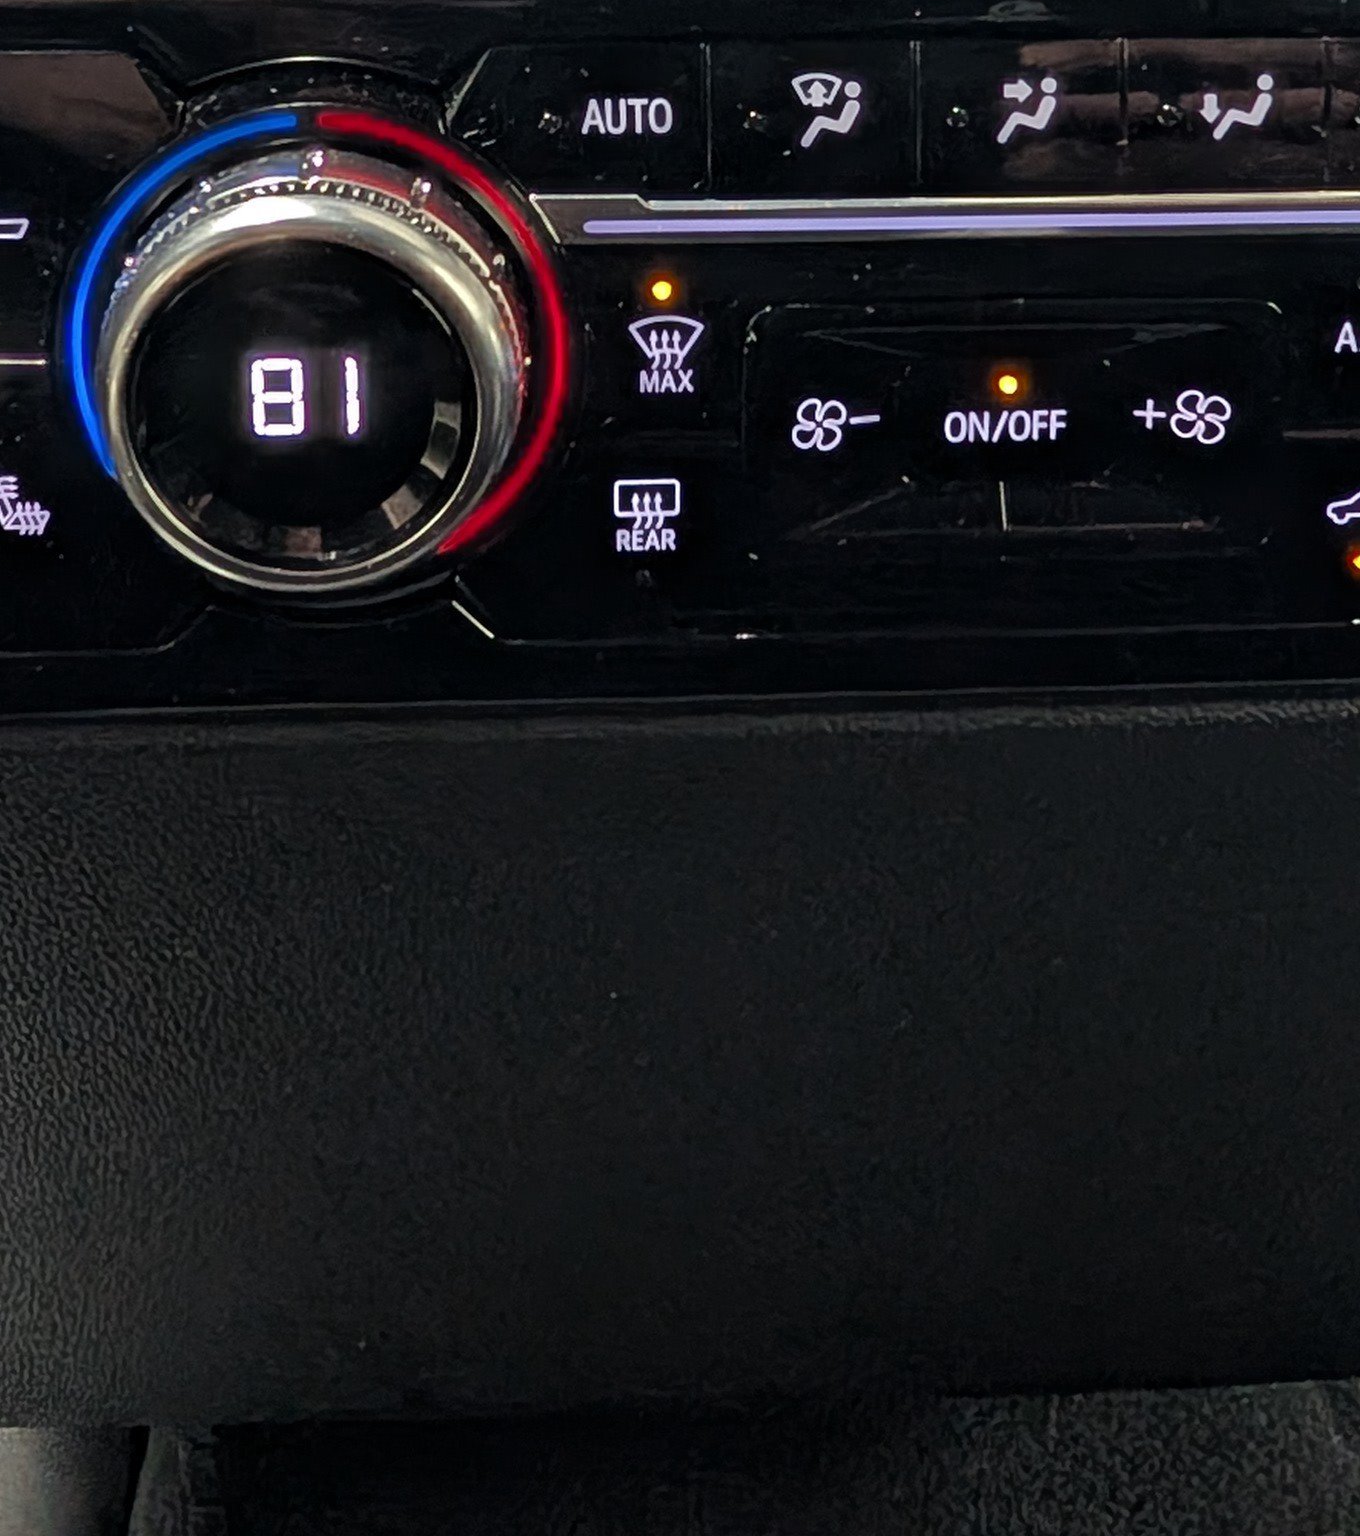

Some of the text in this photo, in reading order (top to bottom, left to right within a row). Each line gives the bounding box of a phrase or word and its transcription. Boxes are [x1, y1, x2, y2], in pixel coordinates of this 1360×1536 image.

[581, 97, 673, 135] AUTO
[250, 356, 360, 437] 81
[639, 367, 694, 394] MAX
[944, 409, 1068, 444] ON/OFF
[615, 526, 676, 552] REAR
